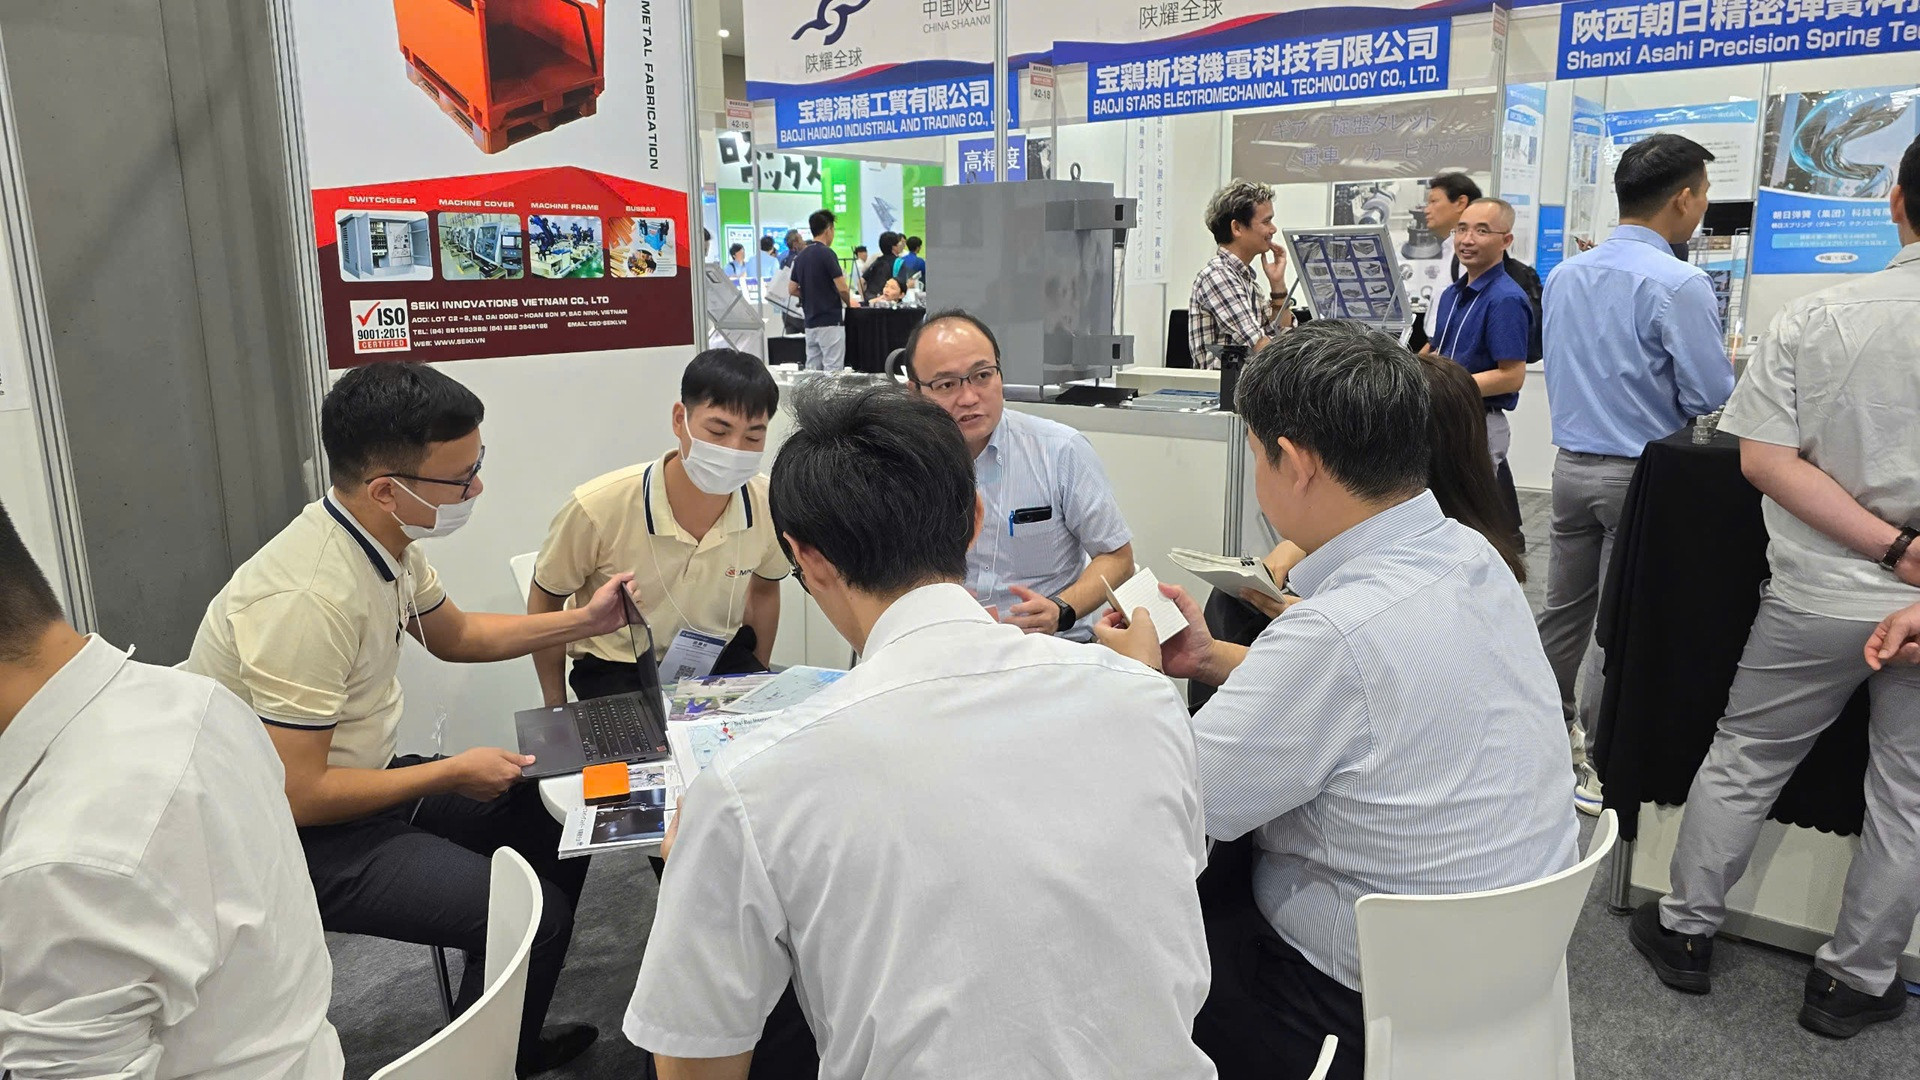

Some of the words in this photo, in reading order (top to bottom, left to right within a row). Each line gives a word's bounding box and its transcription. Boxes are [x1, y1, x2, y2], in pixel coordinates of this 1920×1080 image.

[641, 0, 653, 57] METAL
[923, 21, 950, 34] CHINA
[951, 14, 991, 30] SHAANXI
[1567, 46, 1631, 70] Shanxi
[1636, 40, 1694, 65] Asahi
[1699, 31, 1799, 59] Precision
[1806, 25, 1882, 51] Spring
[1888, 21, 1920, 42] Te
[1093, 97, 1124, 115] BAOJI
[1126, 93, 1162, 112] STARS
[1163, 80, 1289, 108] ELECTROMECHANICAL
[1291, 71, 1378, 96] TECHNOLOGY
[1380, 68, 1406, 88] CO.,
[1409, 65, 1440, 85] LTD.
[645, 63, 658, 170] FABRICATION
[781, 129, 806, 143] BAOJI
[807, 125, 843, 140] HAIQIAO
[844, 120, 898, 137] INDUSTRIAL
[900, 118, 921, 132] AND
[922, 112, 966, 129] TRADING
[968, 111, 989, 127] CO.,
[348, 195, 417, 205] SWITCHGEAR
[438, 199, 482, 207] MACHINE
[484, 200, 515, 208] COVER
[530, 202, 569, 210] MACHINE
[570, 203, 599, 211] FRAME
[625, 205, 657, 213] BUSBAR
[410, 301, 439, 310] SEIKI
[442, 298, 518, 309] INNOVATIONS
[521, 296, 568, 307] VIETNAM
[570, 296, 589, 306] CO.,
[590, 296, 610, 304] LTD
[376, 307, 406, 326] ISO
[357, 328, 407, 340] 9001:2015
[361, 340, 404, 349] CERTIFIED
